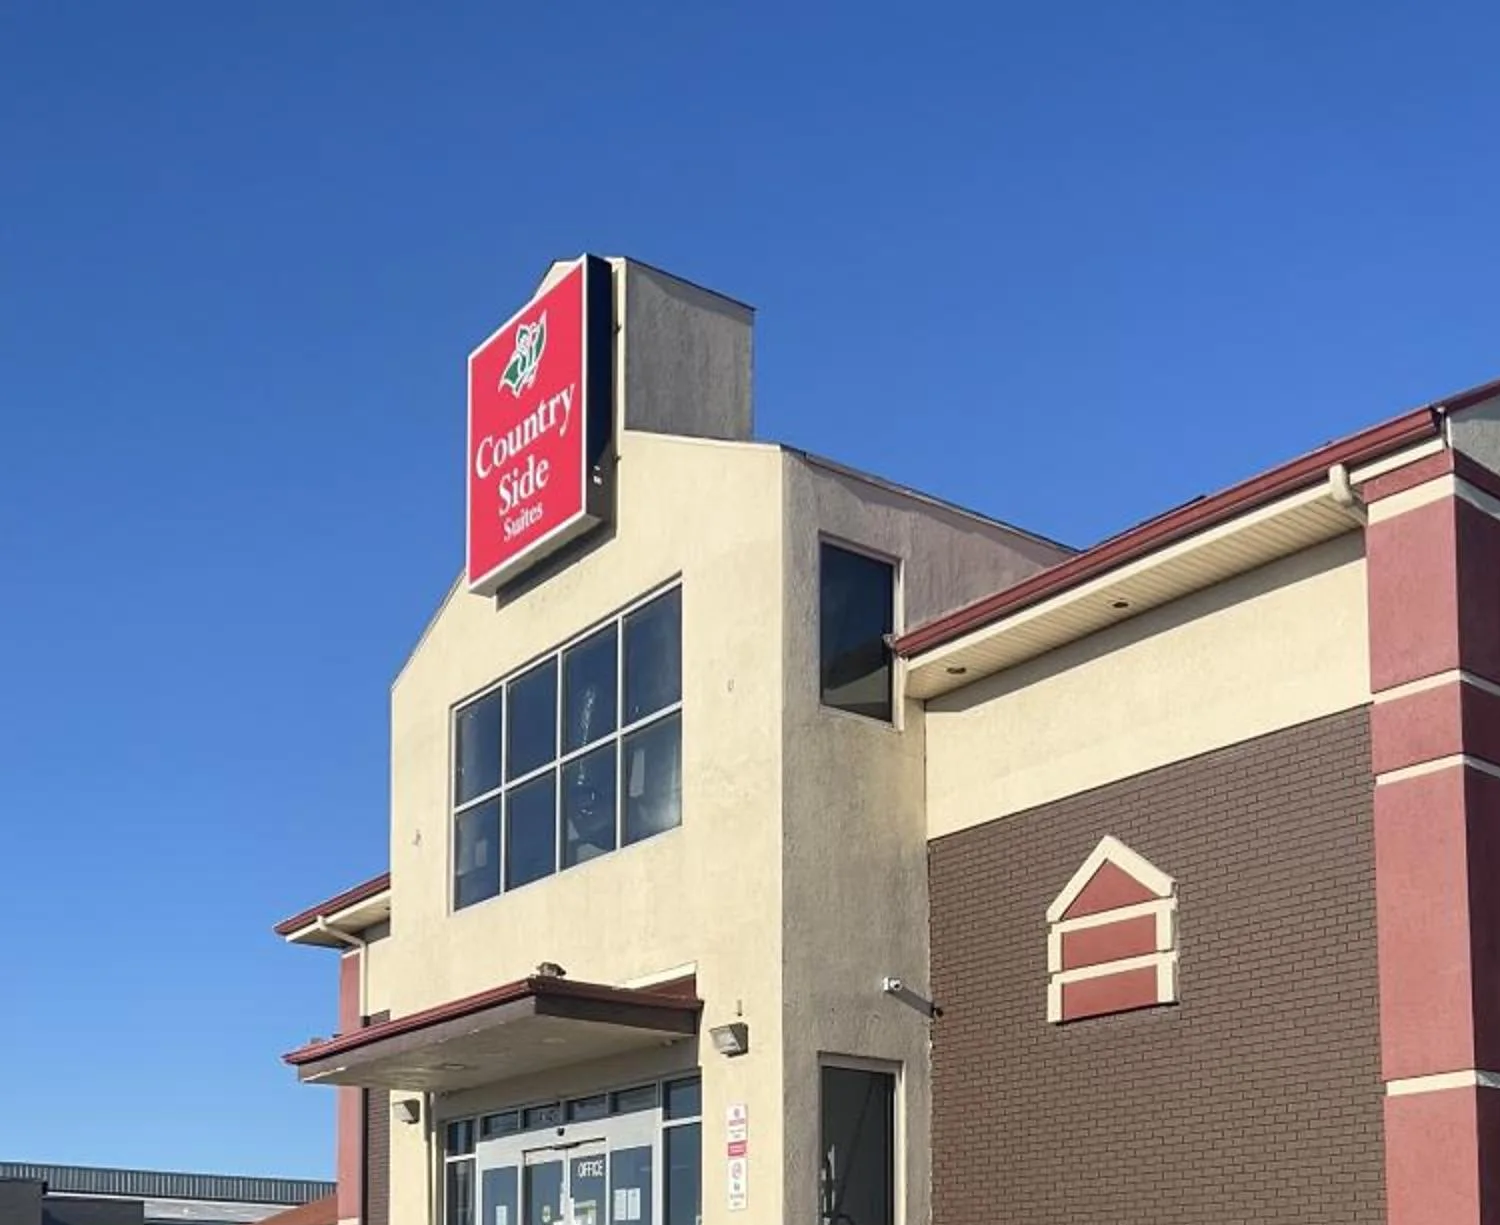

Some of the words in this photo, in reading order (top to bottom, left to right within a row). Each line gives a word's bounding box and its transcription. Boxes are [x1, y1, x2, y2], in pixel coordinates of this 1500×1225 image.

[475, 384, 576, 479] Country
[499, 457, 549, 515] Side
[503, 501, 543, 541] Suites
[577, 1159, 604, 1177] OFFICE
